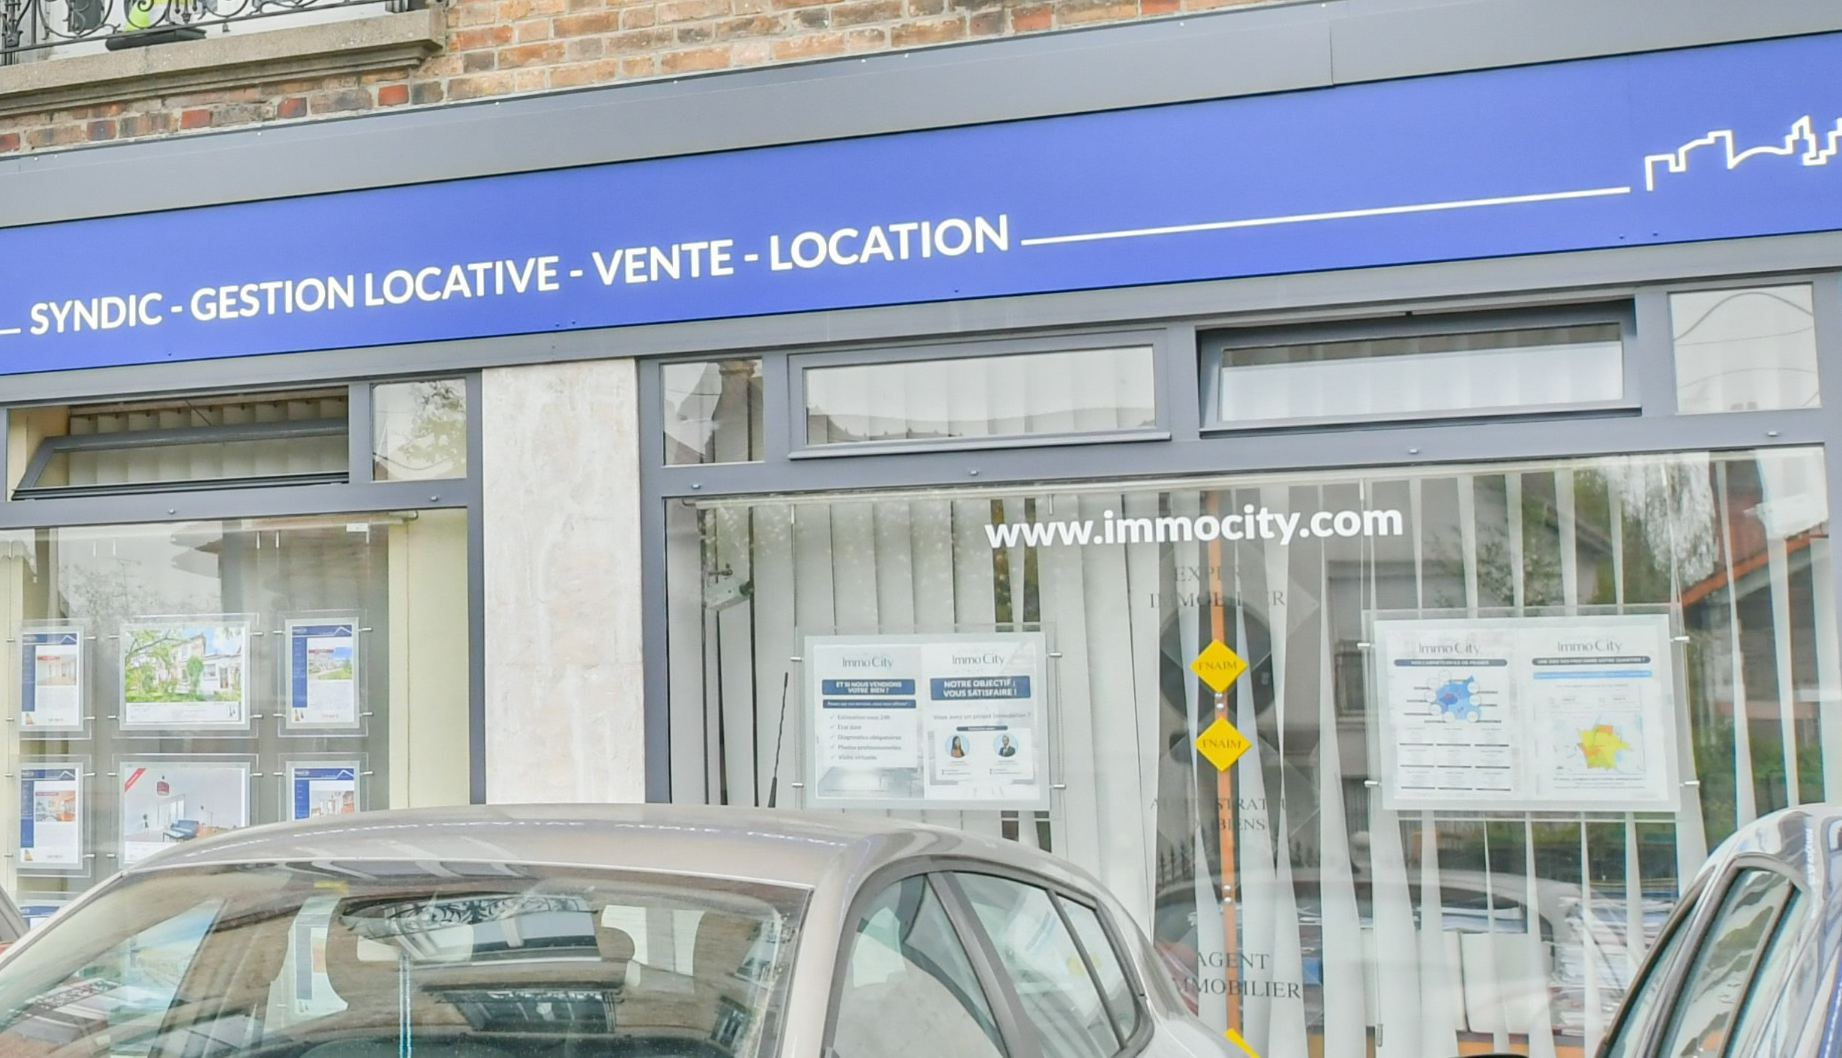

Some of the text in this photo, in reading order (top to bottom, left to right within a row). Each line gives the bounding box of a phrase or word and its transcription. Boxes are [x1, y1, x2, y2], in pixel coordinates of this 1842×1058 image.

[29, 291, 162, 336] SYNDIC
[190, 274, 354, 323] GESTION
[365, 255, 559, 308] LOCATIVE
[591, 239, 734, 287] VENTE
[770, 214, 1009, 272] LOCATION
[985, 504, 1404, 548] www.immocity.com
[1198, 661, 1237, 671] FNAIM
[944, 680, 972, 688] NOTRE
[973, 678, 1011, 688] OBJECTIF
[943, 689, 967, 697] VOUS
[967, 688, 1013, 697] SATISFAIRE
[1202, 739, 1241, 749] FNAIM
[1195, 952, 1270, 970] AGENT
[1171, 978, 1301, 999] MMOBILIER
